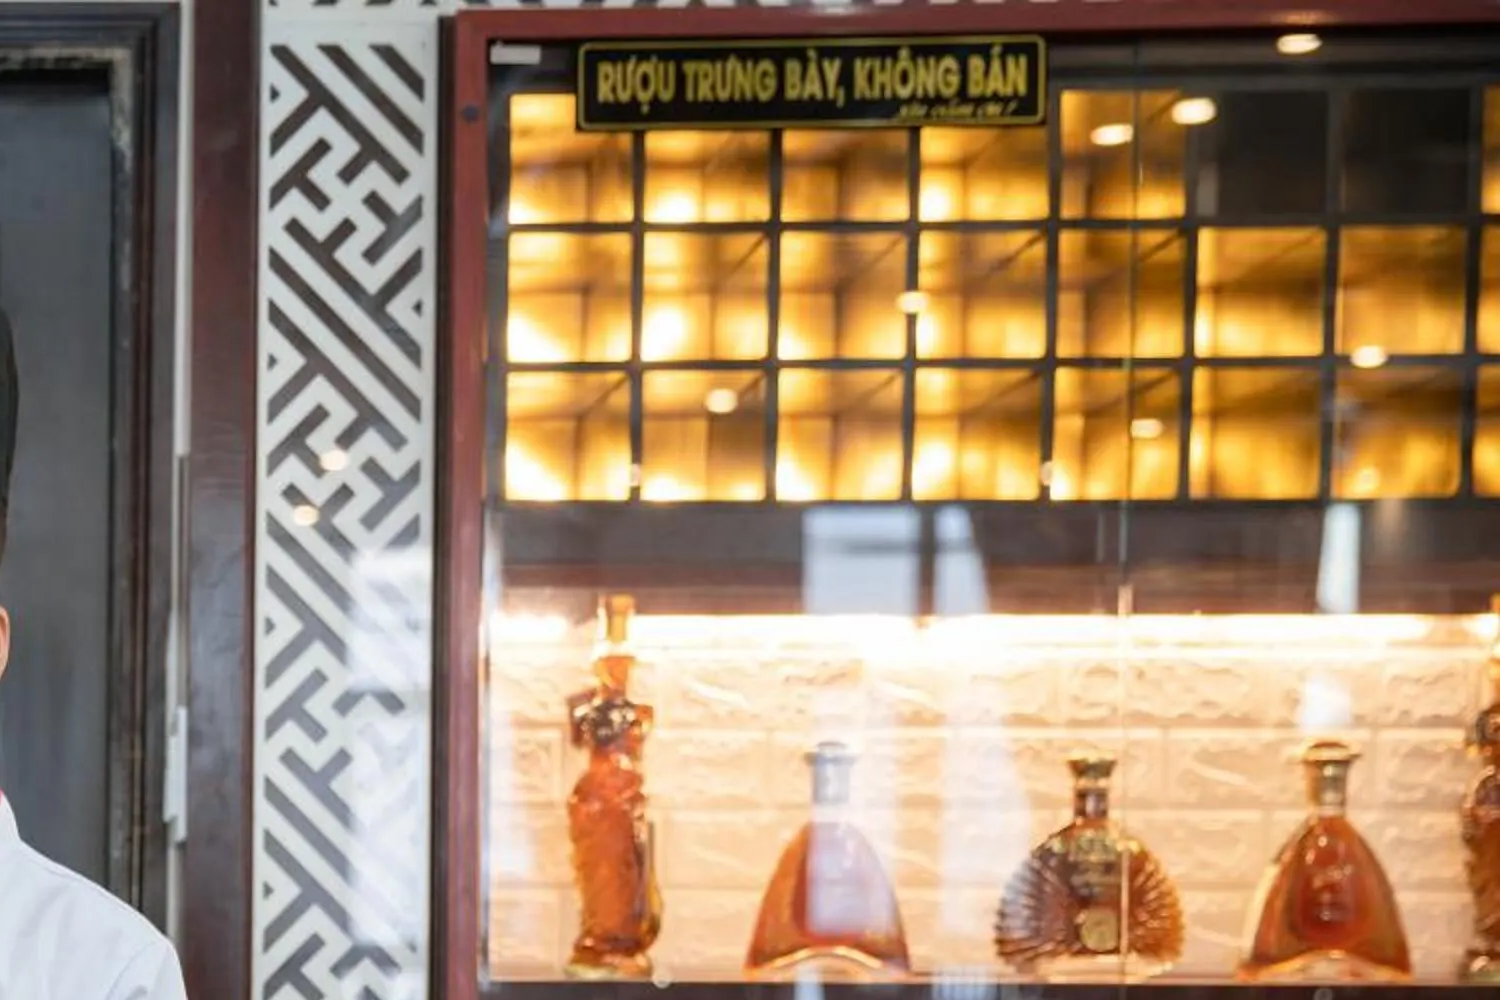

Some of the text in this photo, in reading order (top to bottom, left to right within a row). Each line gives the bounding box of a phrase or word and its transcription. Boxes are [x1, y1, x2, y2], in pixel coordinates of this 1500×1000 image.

[597, 55, 676, 115] RƯỢU
[784, 48, 846, 108] BÀY,
[853, 46, 961, 100] KHÔNG
[966, 43, 1028, 98] BÁN
